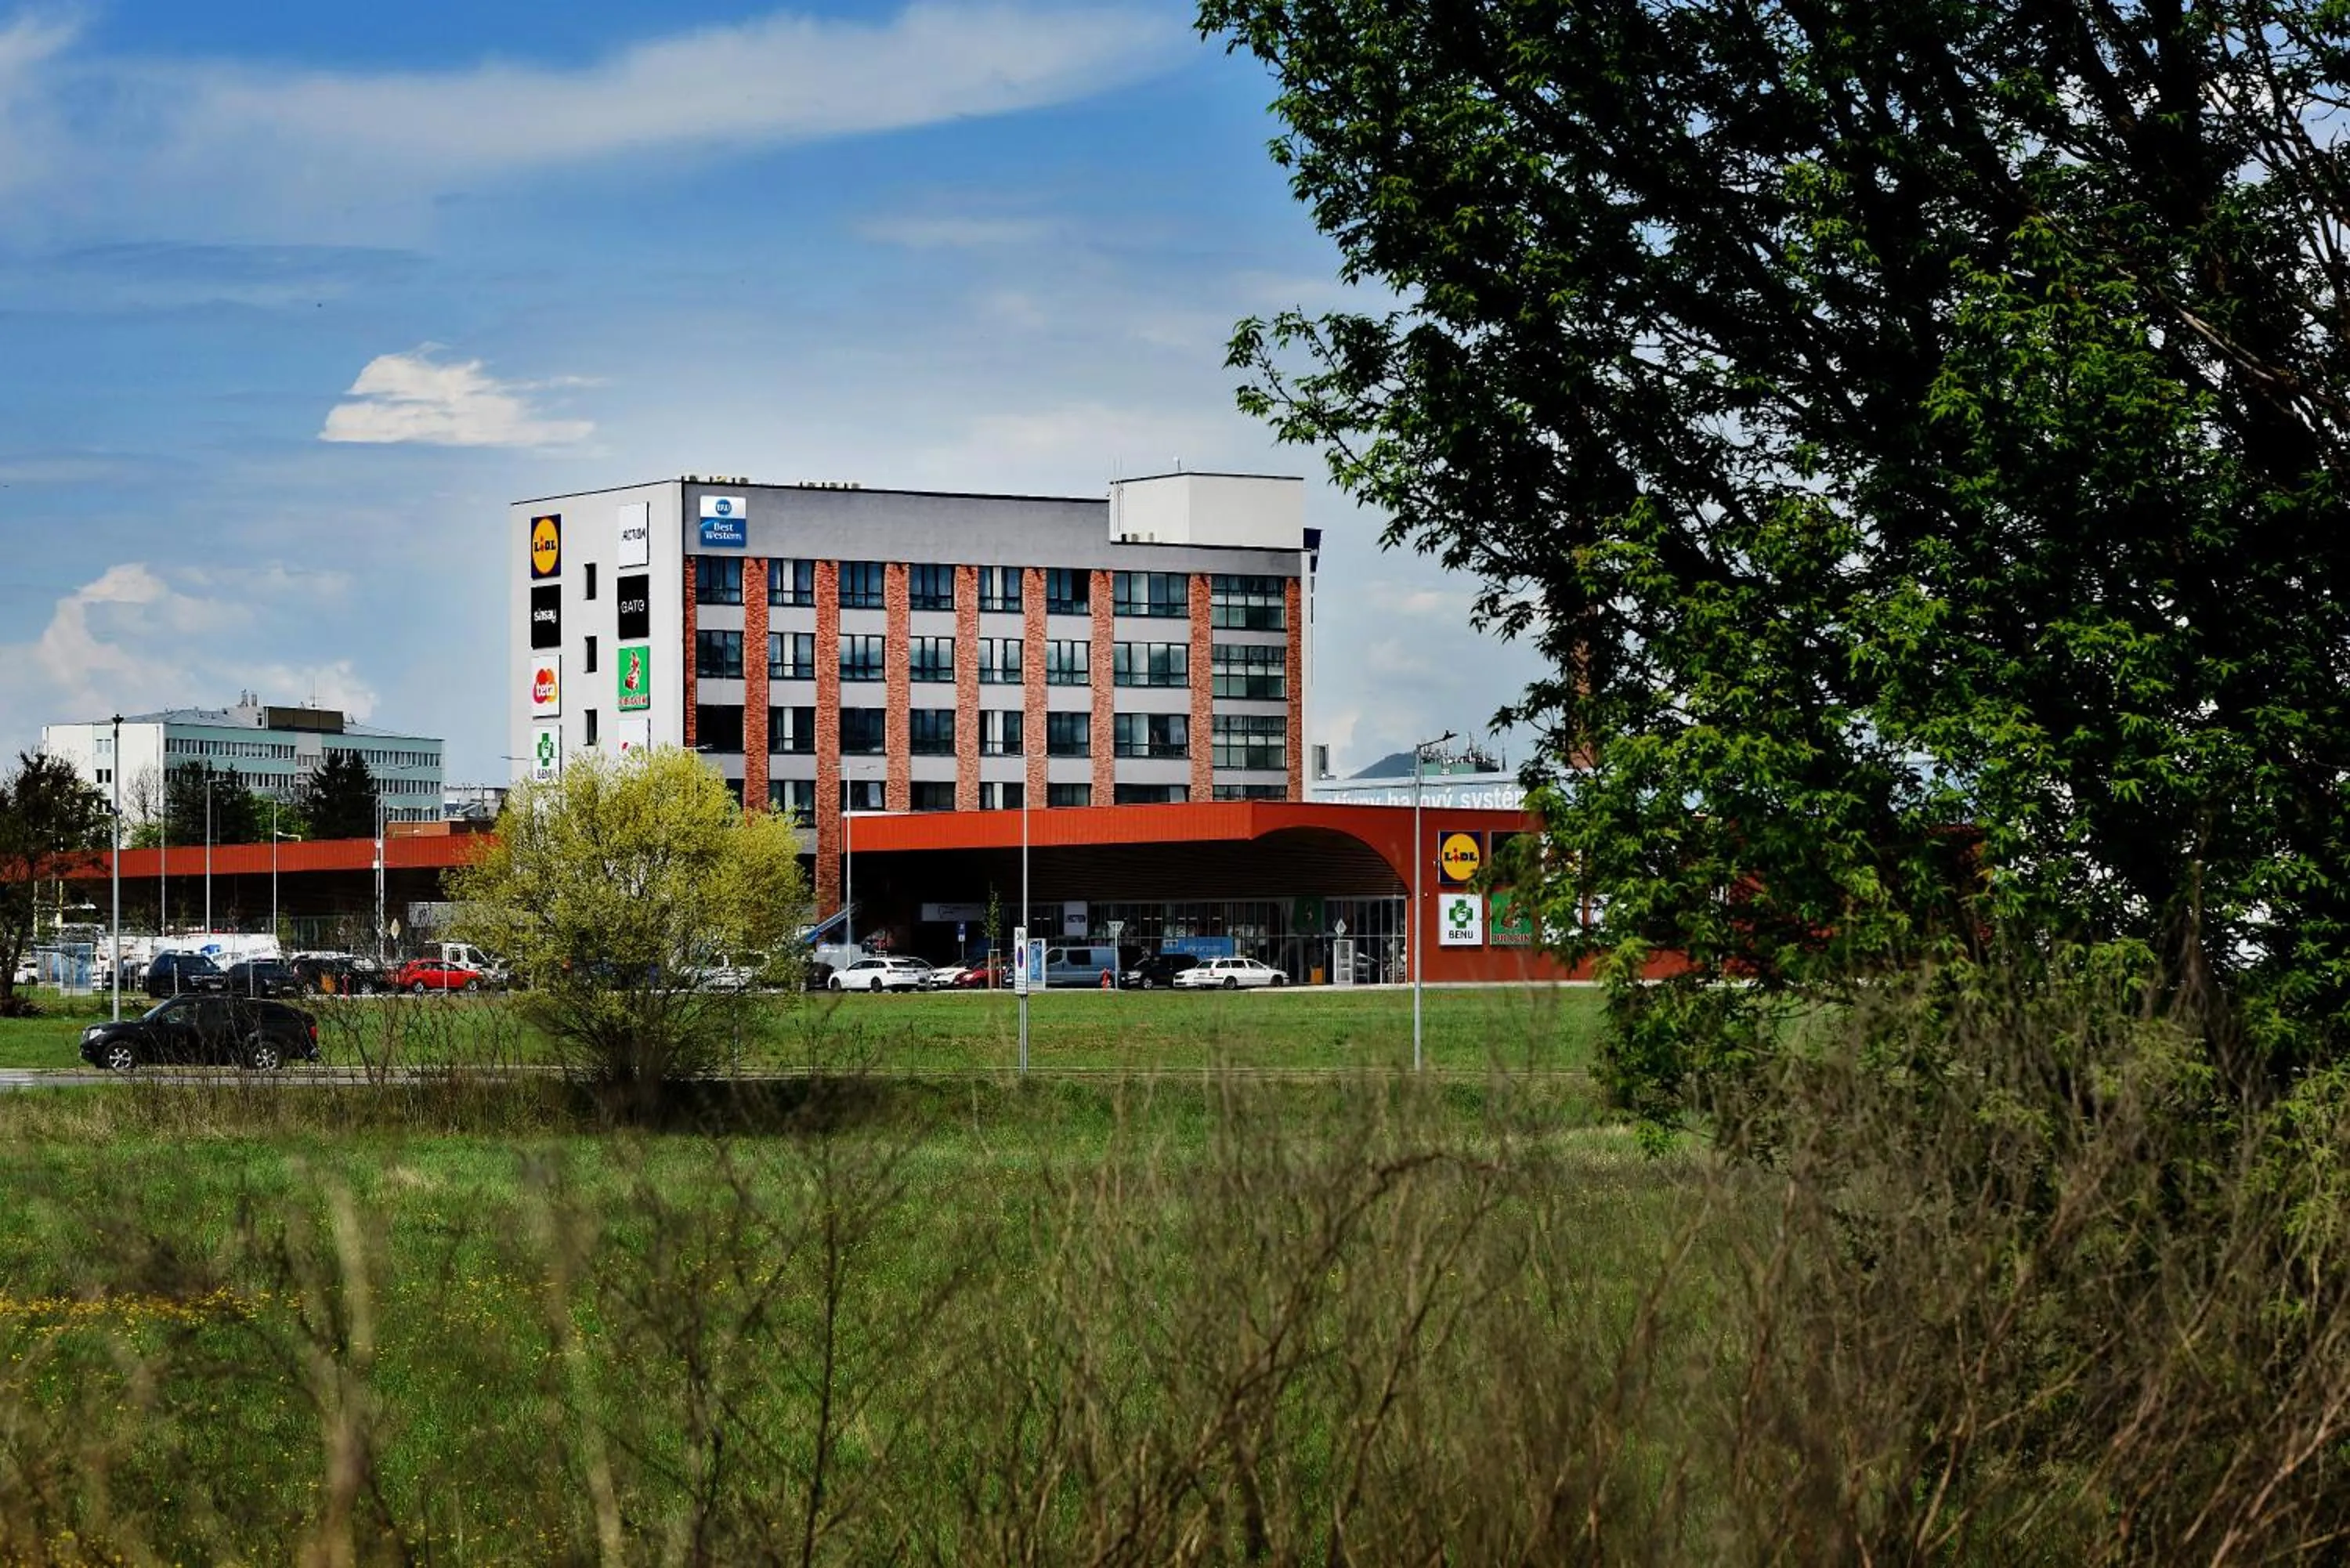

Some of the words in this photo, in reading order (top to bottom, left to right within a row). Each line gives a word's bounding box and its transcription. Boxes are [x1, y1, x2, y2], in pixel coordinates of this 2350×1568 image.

[714, 522, 733, 532] Best
[705, 531, 742, 540] Western
[620, 599, 645, 613] GATO
[1448, 930, 1473, 939] BENU
